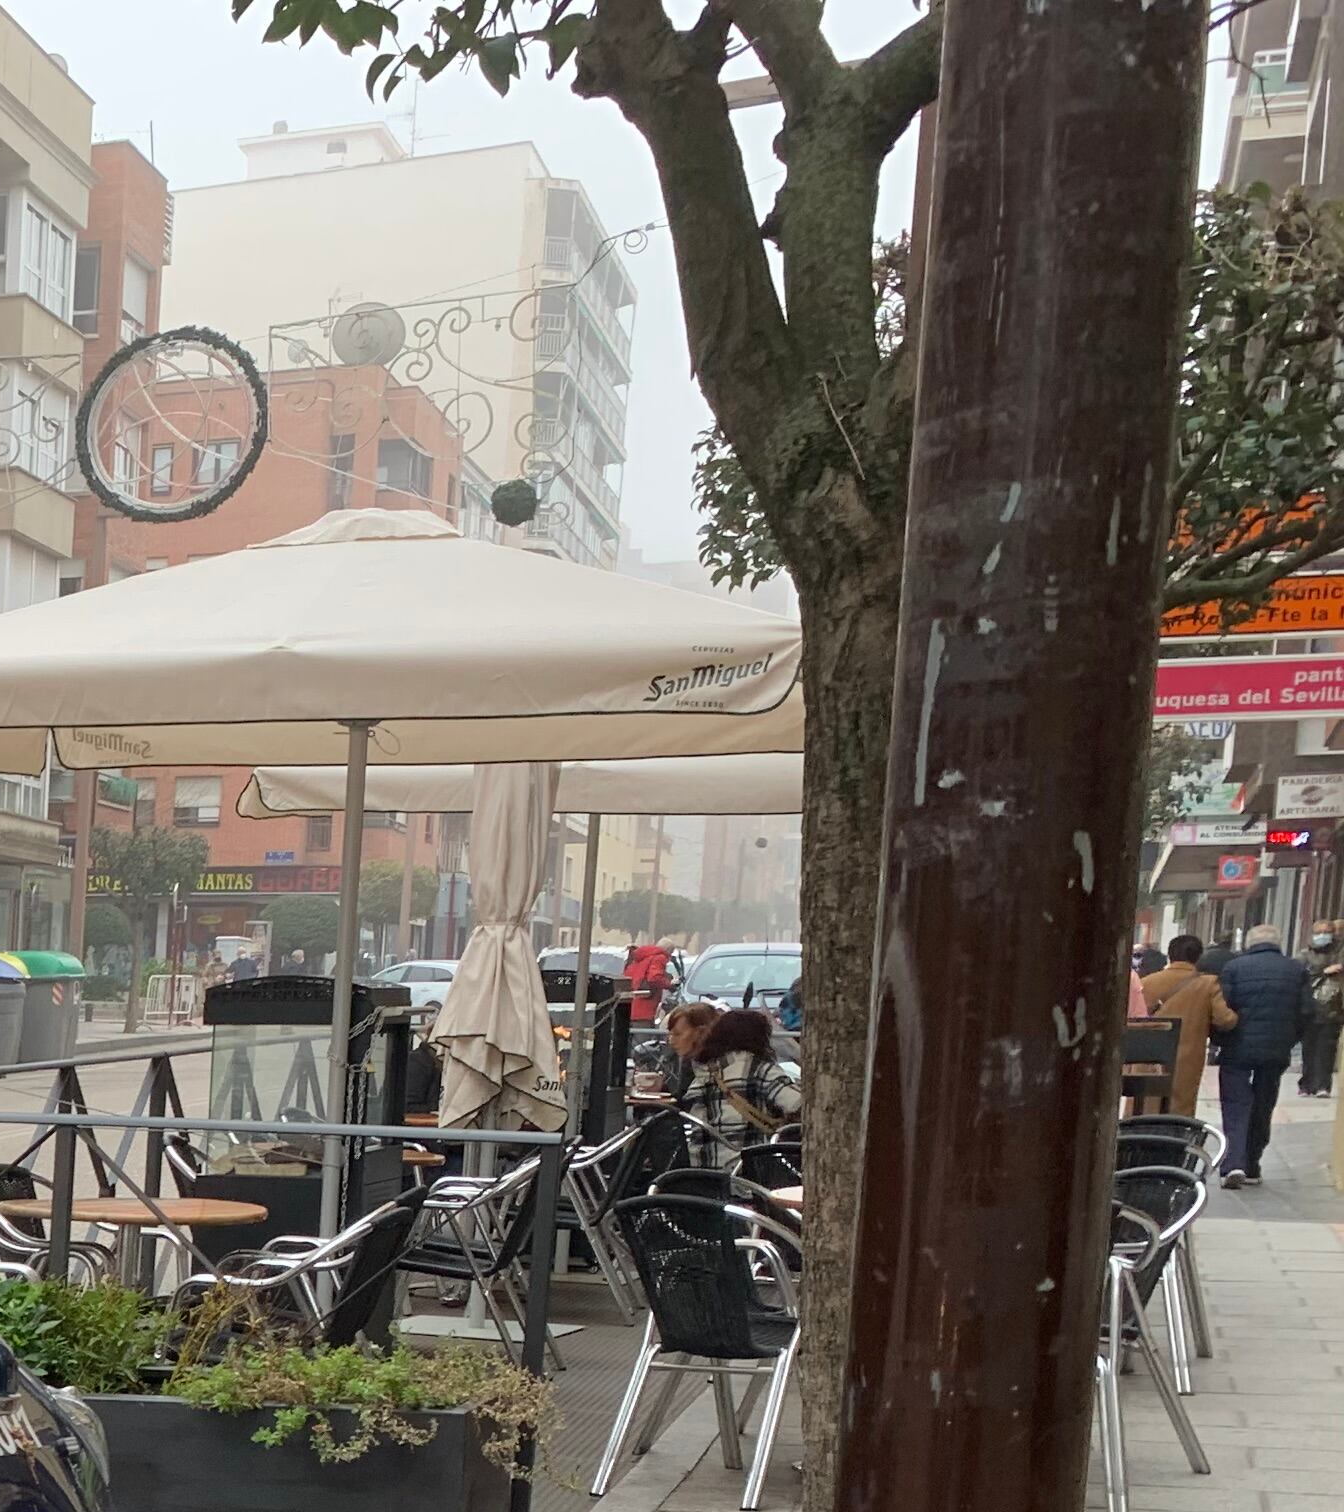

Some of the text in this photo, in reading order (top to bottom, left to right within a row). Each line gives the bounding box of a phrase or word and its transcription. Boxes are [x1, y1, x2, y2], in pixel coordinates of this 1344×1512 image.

[692, 645, 735, 653] CERVEZAS
[1156, 685, 1344, 710] uquesa del Sevill
